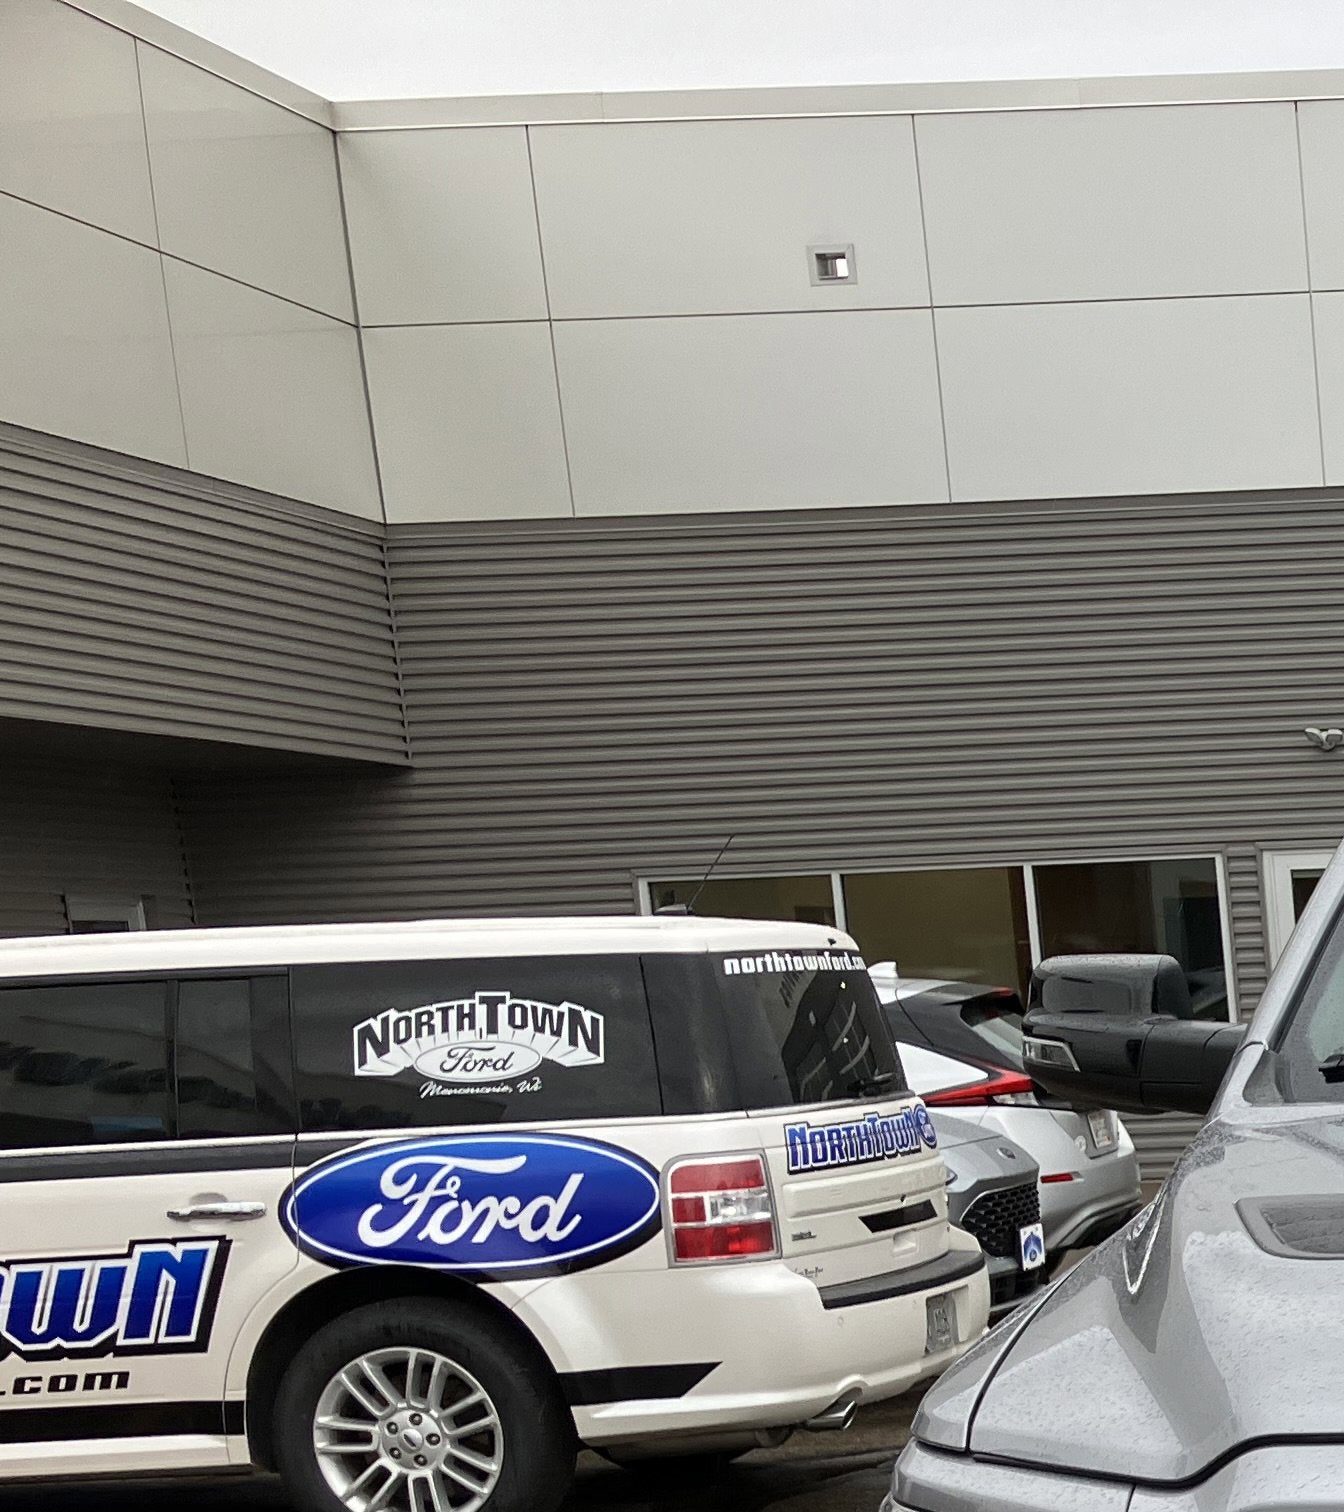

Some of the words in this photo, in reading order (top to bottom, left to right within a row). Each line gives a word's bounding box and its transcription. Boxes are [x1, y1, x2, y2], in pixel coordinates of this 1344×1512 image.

[440, 1046, 514, 1073] Ford
[358, 1155, 584, 1246] Ford
[0, 1244, 215, 1349] WN
